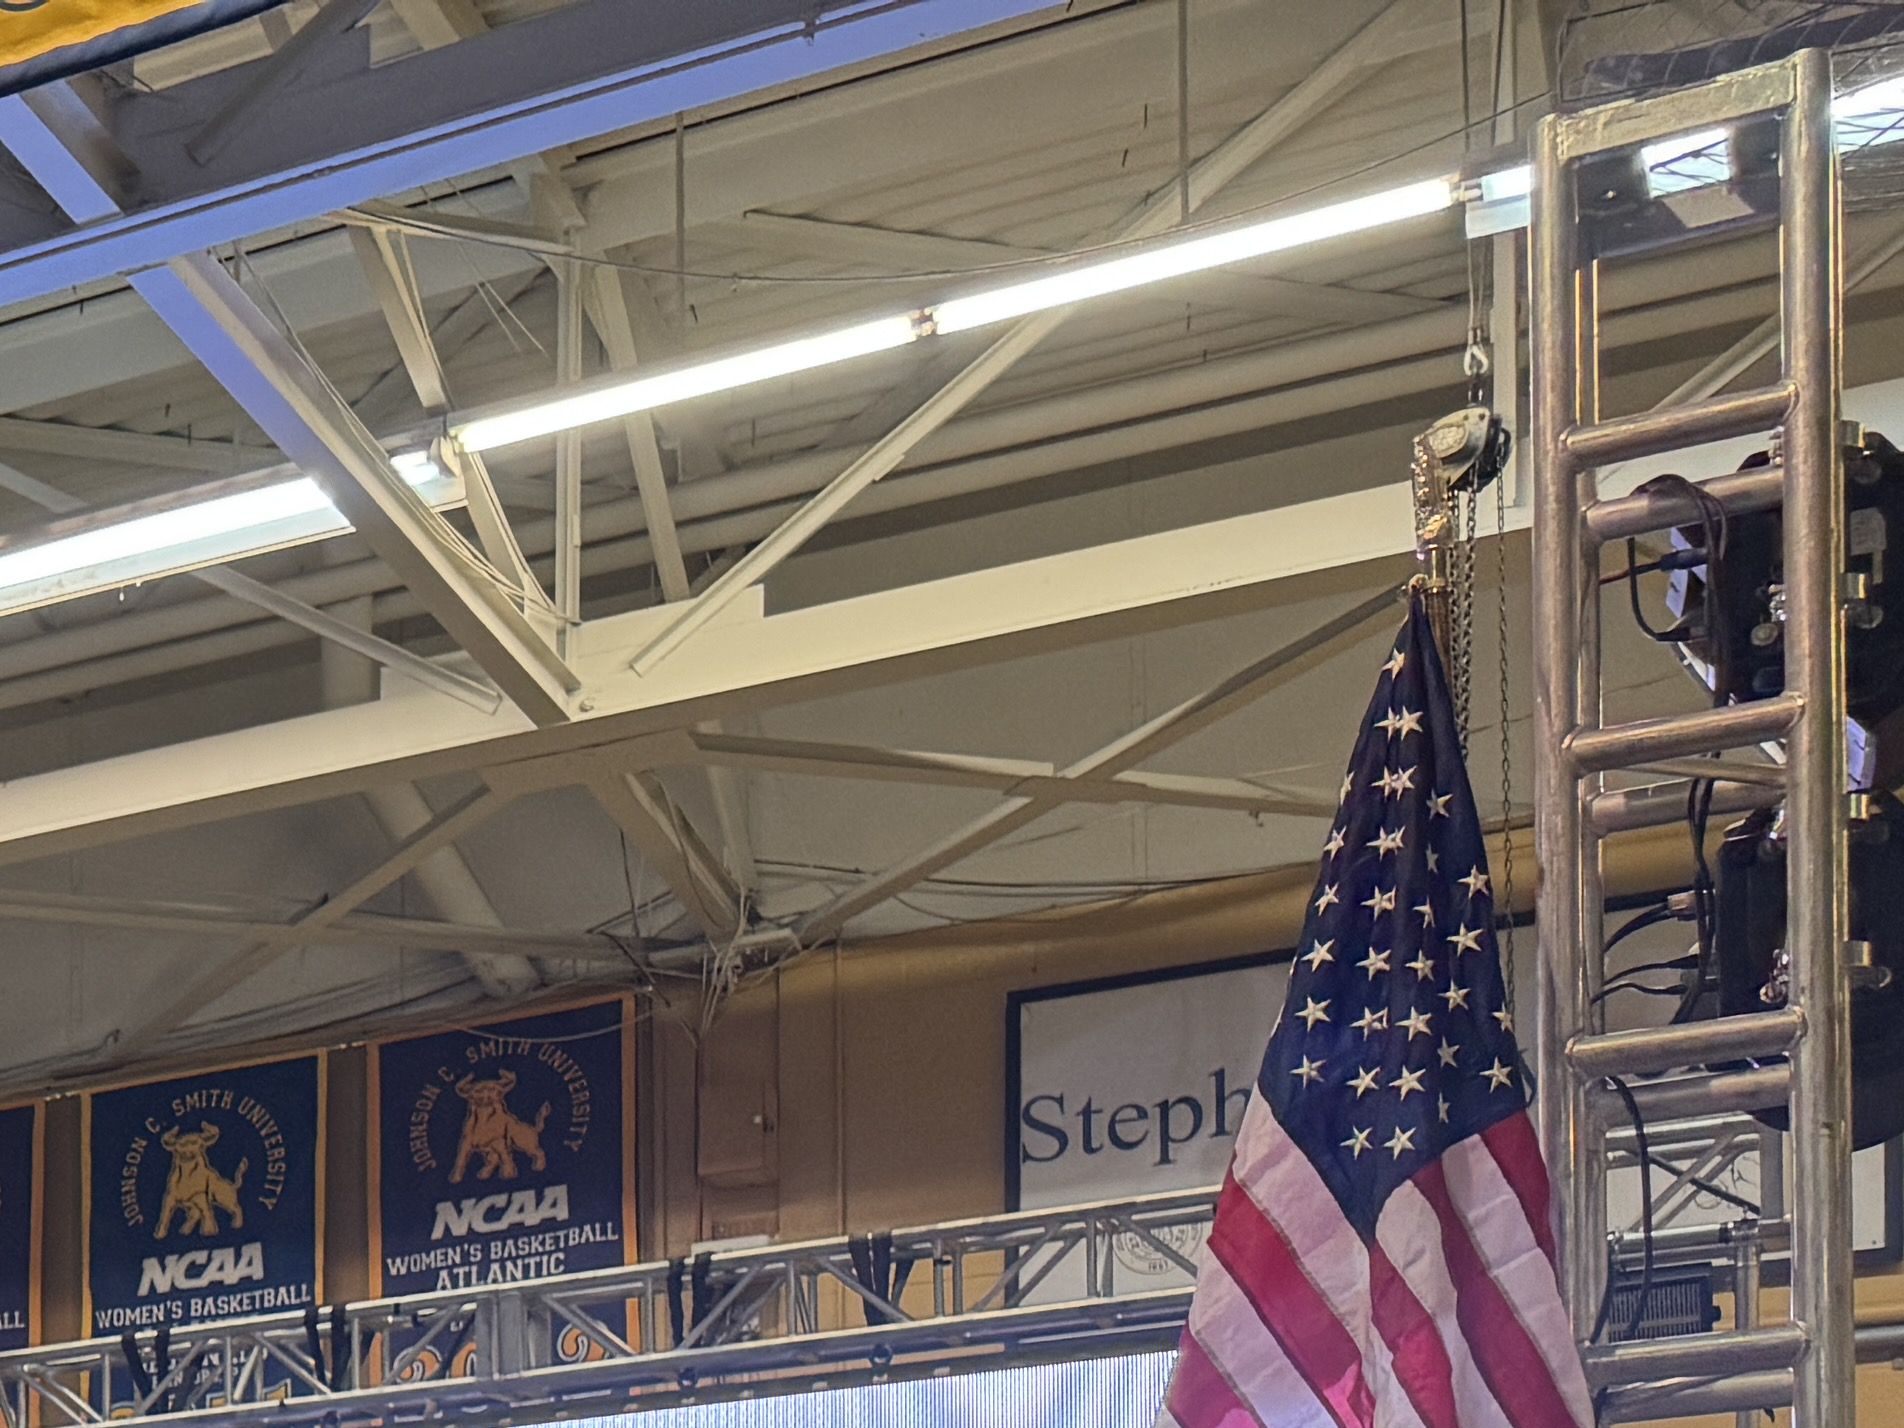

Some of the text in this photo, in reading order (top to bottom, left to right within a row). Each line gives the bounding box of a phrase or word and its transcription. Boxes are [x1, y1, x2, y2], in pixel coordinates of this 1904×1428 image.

[465, 1037, 532, 1065] SMITH
[537, 1042, 594, 1153] UNIVERSITY
[1021, 1067, 1253, 1167] Steph
[172, 1088, 235, 1118] SMITH
[237, 1096, 288, 1211] UNIVERSITY
[430, 1183, 570, 1241] NCAA
[137, 1241, 265, 1297] NCAA
[386, 1221, 619, 1276] WOMEN'S BASKETBALL
[436, 1252, 566, 1292] ATLANTIC
[95, 1283, 313, 1330] WOMEN'S BASKETBALL
